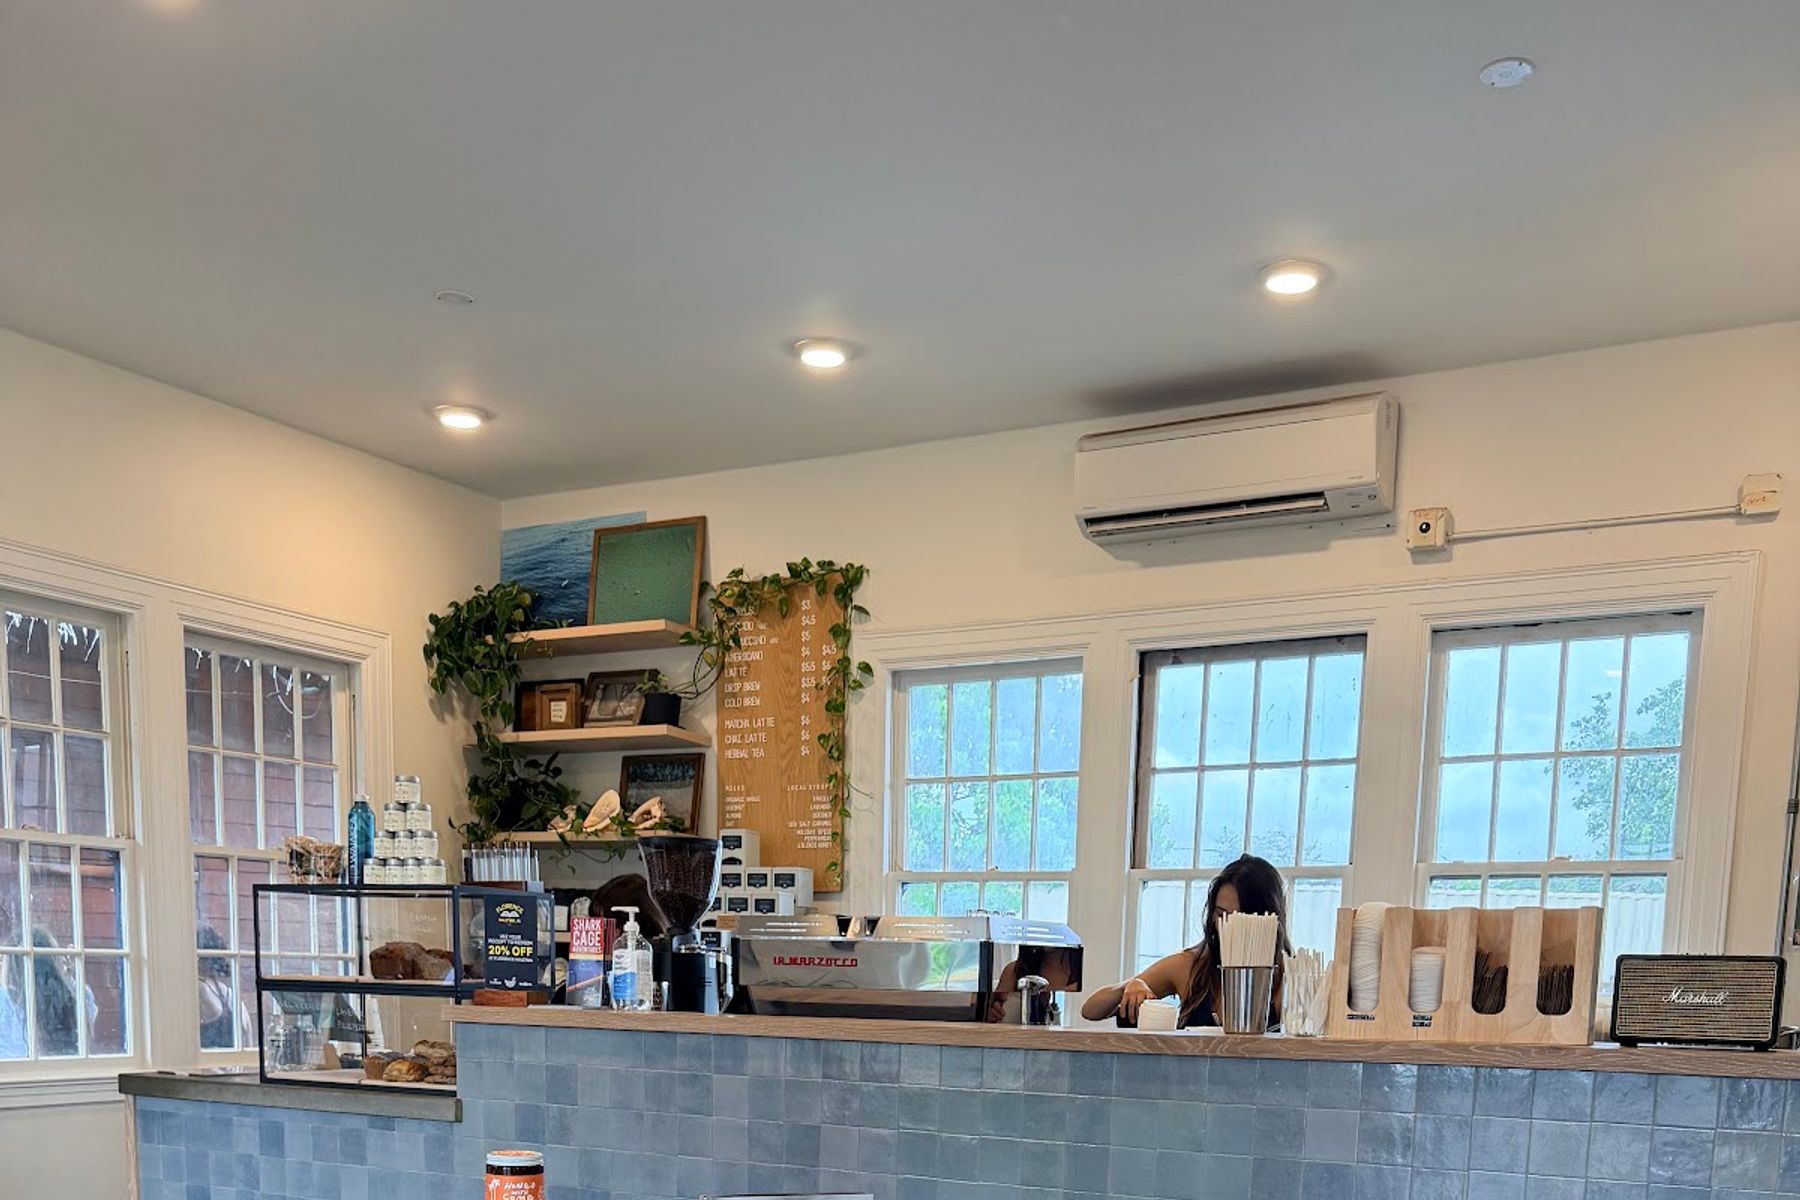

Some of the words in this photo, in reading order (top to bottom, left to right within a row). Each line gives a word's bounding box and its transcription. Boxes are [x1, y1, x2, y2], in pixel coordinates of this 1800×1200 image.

[725, 651, 763, 662] AMERICANO
[725, 666, 747, 677] LATTE
[725, 683, 742, 692] DRIP
[743, 682, 761, 691] BREW
[725, 698, 742, 708] COLD
[743, 696, 761, 706] BREW
[725, 719, 749, 729] MATCHA
[753, 717, 775, 728] LATTE
[725, 734, 742, 744] CHAI
[746, 732, 768, 743] LATTE
[725, 749, 749, 759] HERBAL
[752, 748, 765, 758] TEA
[573, 918, 601, 930] SHARK
[573, 931, 601, 946] CAGE
[488, 945, 511, 956] 20%
[512, 946, 533, 957] OFF
[1662, 984, 1729, 1005] Marshall
